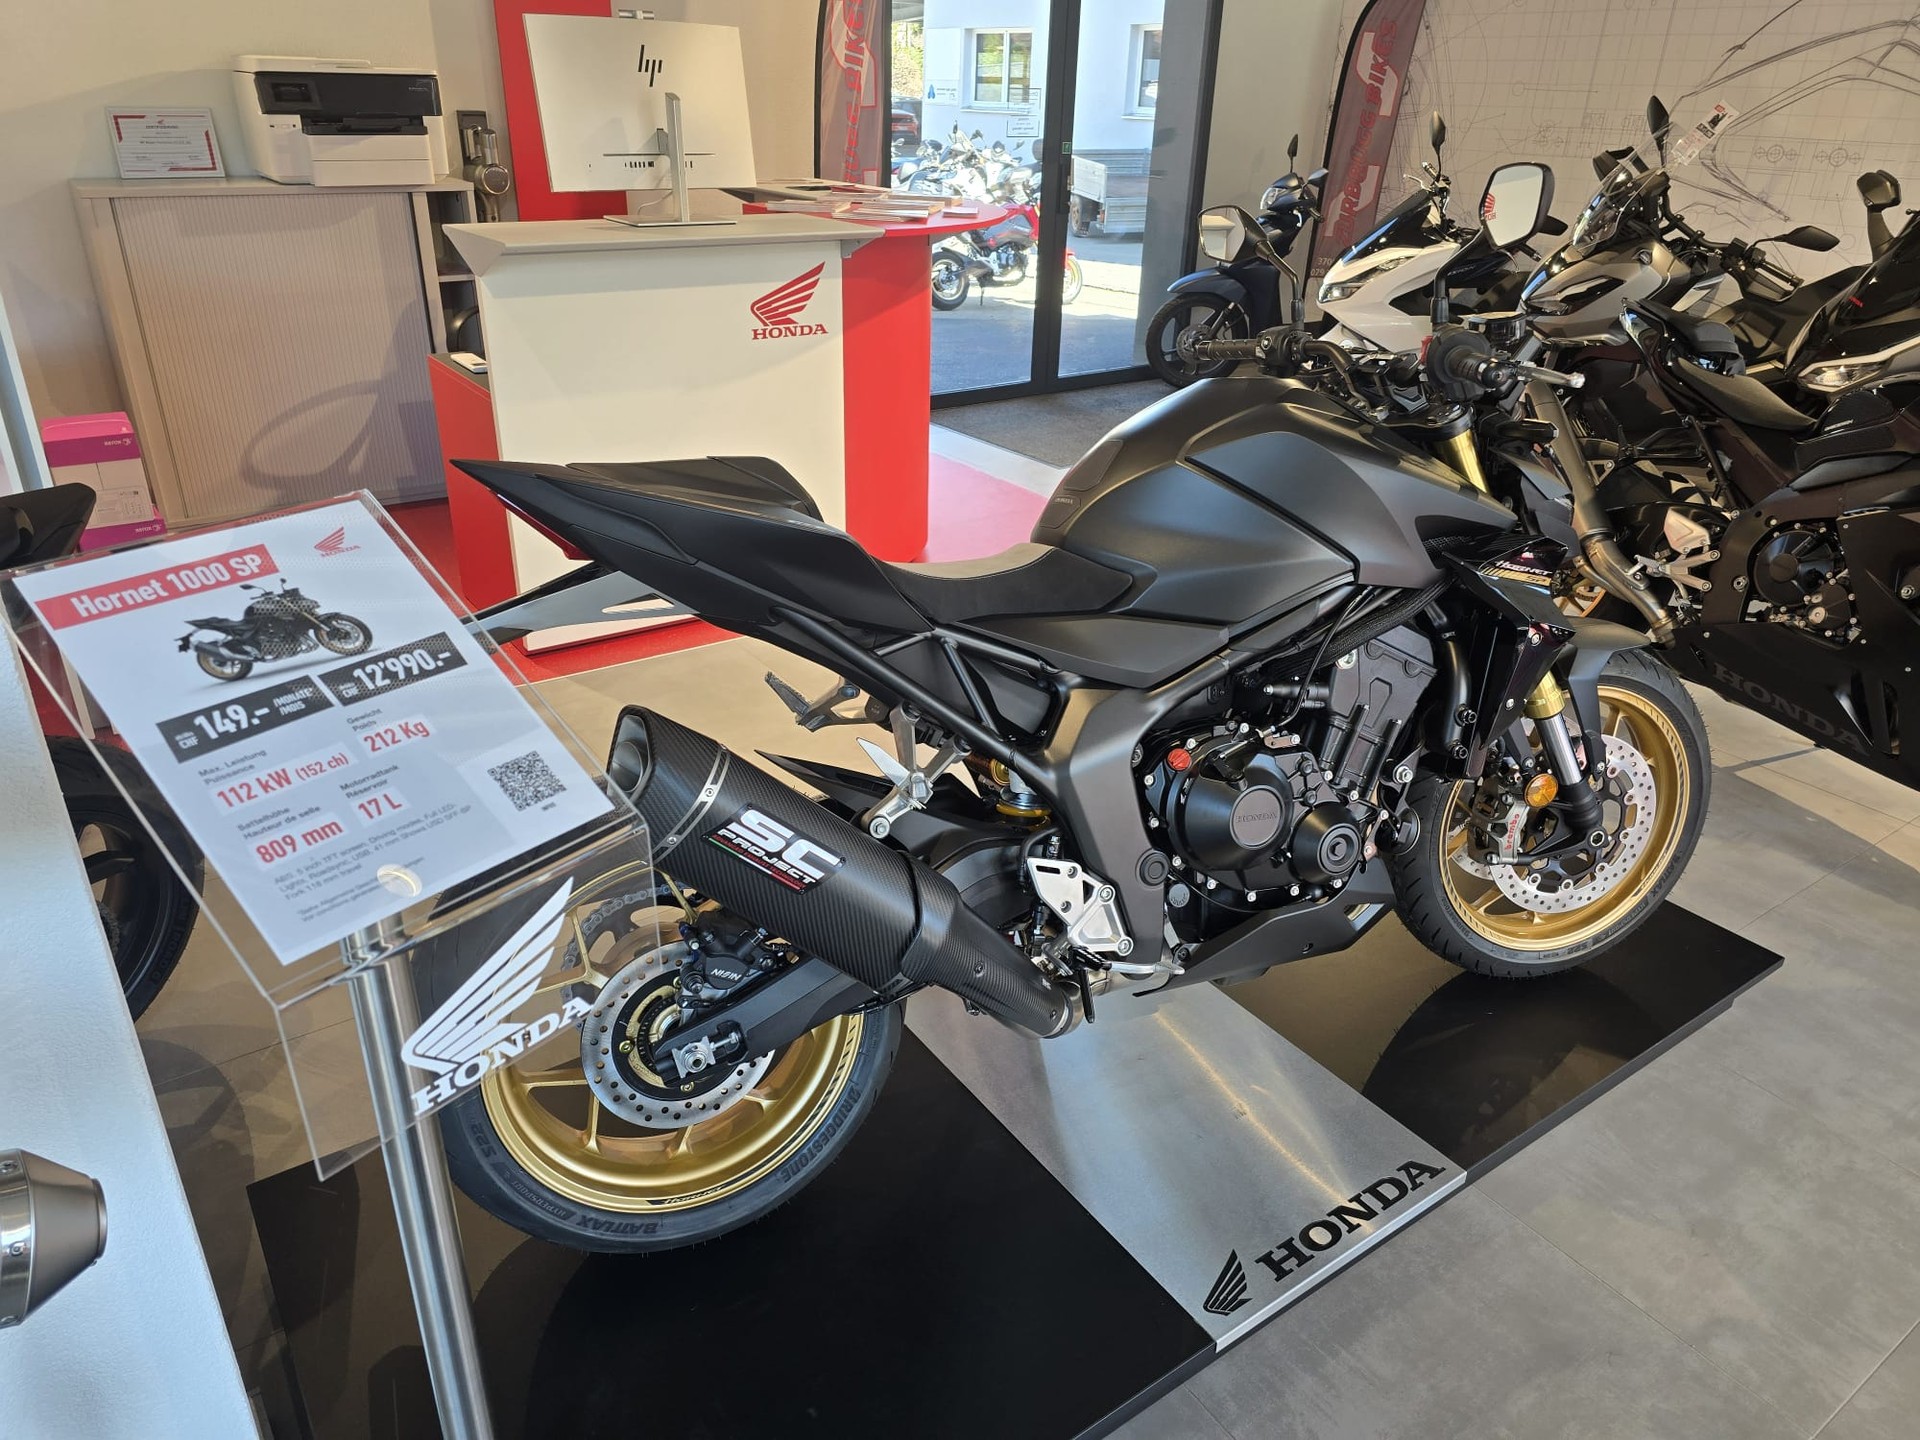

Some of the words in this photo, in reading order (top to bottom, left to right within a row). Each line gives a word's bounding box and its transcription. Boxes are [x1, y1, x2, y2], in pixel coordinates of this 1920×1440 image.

[637, 44, 663, 88] hp
[1365, 19, 1398, 109] BIKES
[751, 323, 829, 340] HONDA
[319, 544, 362, 558] HONDA
[70, 580, 169, 619] Hornet
[167, 562, 231, 593] 1000
[229, 553, 264, 577] SP
[353, 649, 452, 690] 12'990.-
[193, 703, 271, 740] 149.-
[1713, 662, 1870, 757] HONDA
[363, 726, 401, 752] 212
[399, 718, 430, 742] Kg
[216, 782, 258, 808] 112
[255, 767, 293, 794] kW
[295, 761, 327, 781] (152
[327, 752, 350, 768] ch)
[224, 749, 268, 769] Leistung
[243, 817, 284, 840] Hauteur
[283, 813, 298, 824] de
[298, 805, 322, 818] selle
[357, 798, 383, 820] 17
[384, 793, 403, 810] L
[255, 833, 298, 865] 809
[301, 820, 344, 847] mm
[1504, 813, 1520, 851] brembo
[717, 828, 816, 884] PROJECT
[412, 996, 595, 1116] HONDA
[780, 1086, 861, 1183] BRIDGESTONE
[576, 1213, 658, 1235] BATTLAX
[1254, 1160, 1446, 1282] HONDA
